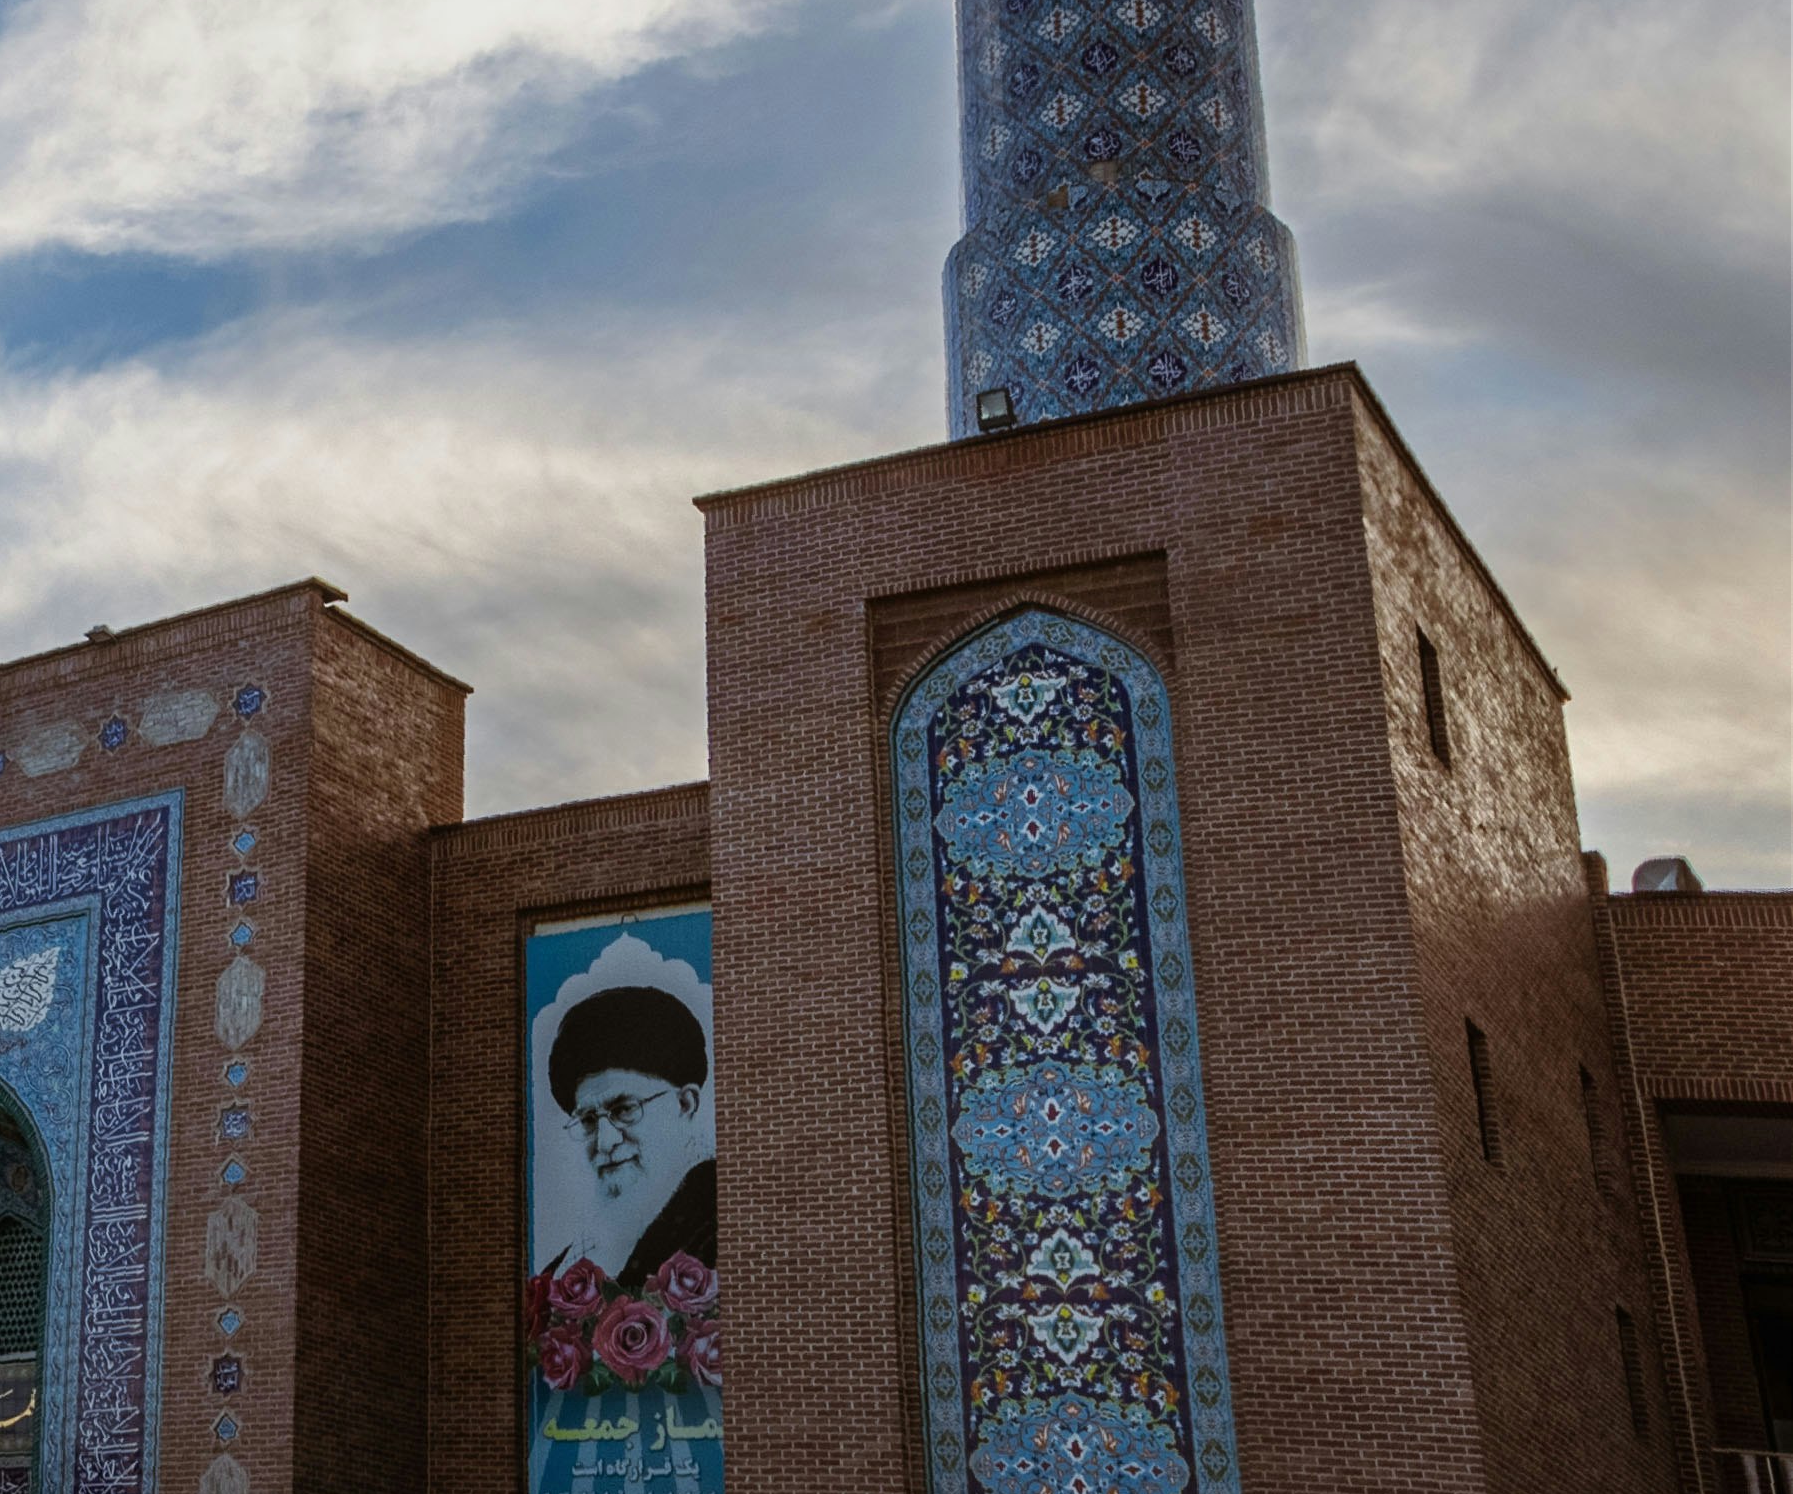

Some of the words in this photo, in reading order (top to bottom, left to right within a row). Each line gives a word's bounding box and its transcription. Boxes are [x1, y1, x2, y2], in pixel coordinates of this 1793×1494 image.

[543, 1416, 640, 1451] جمعه
[650, 1404, 724, 1451] ماز
[572, 1457, 603, 1477] است
[606, 1456, 672, 1482] قرارگاه
[675, 1457, 700, 1480] یک
